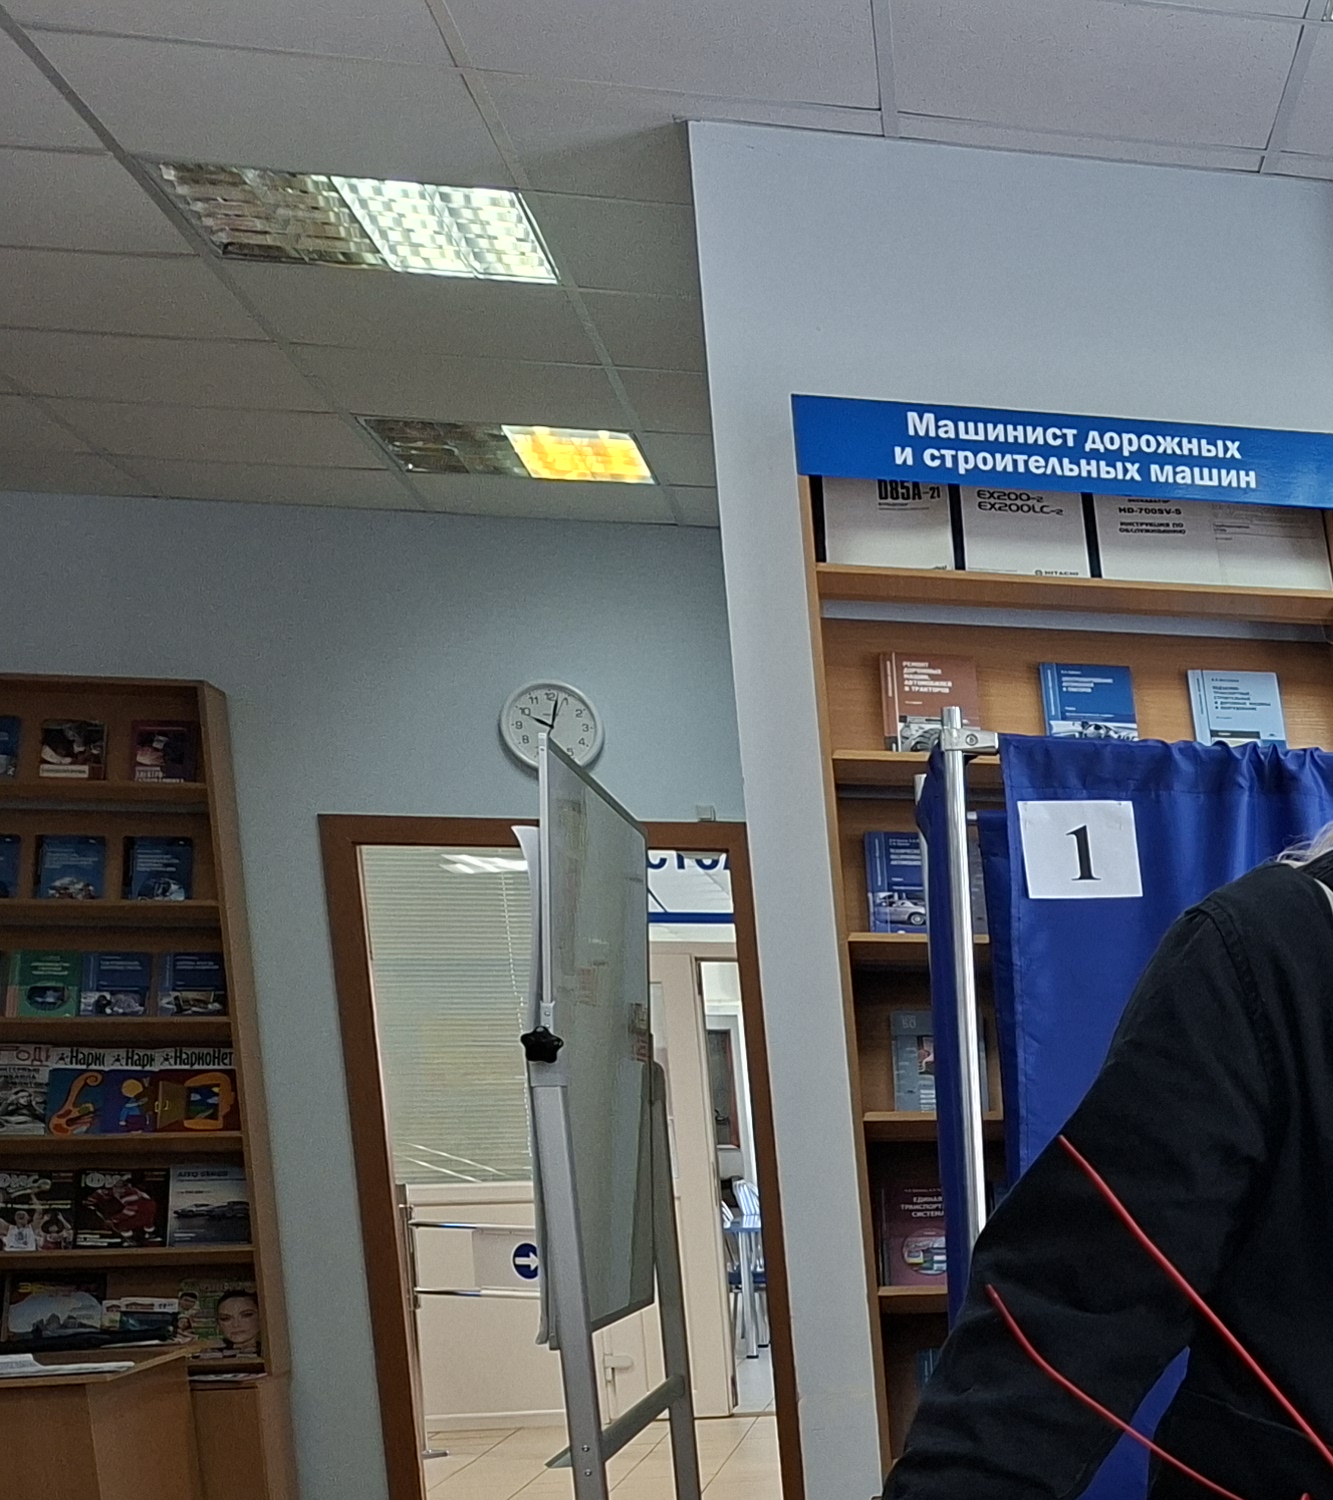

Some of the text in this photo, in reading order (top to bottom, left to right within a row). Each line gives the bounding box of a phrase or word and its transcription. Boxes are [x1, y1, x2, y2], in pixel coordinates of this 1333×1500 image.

[906, 411, 1242, 460] Машинист дорожных
[894, 446, 1257, 489] и строительных машин
[976, 488, 1044, 503] EX200-2
[977, 501, 1064, 516] EX200LC-2
[1065, 823, 1102, 881] 1
[173, 1047, 233, 1068] НаркоНет
